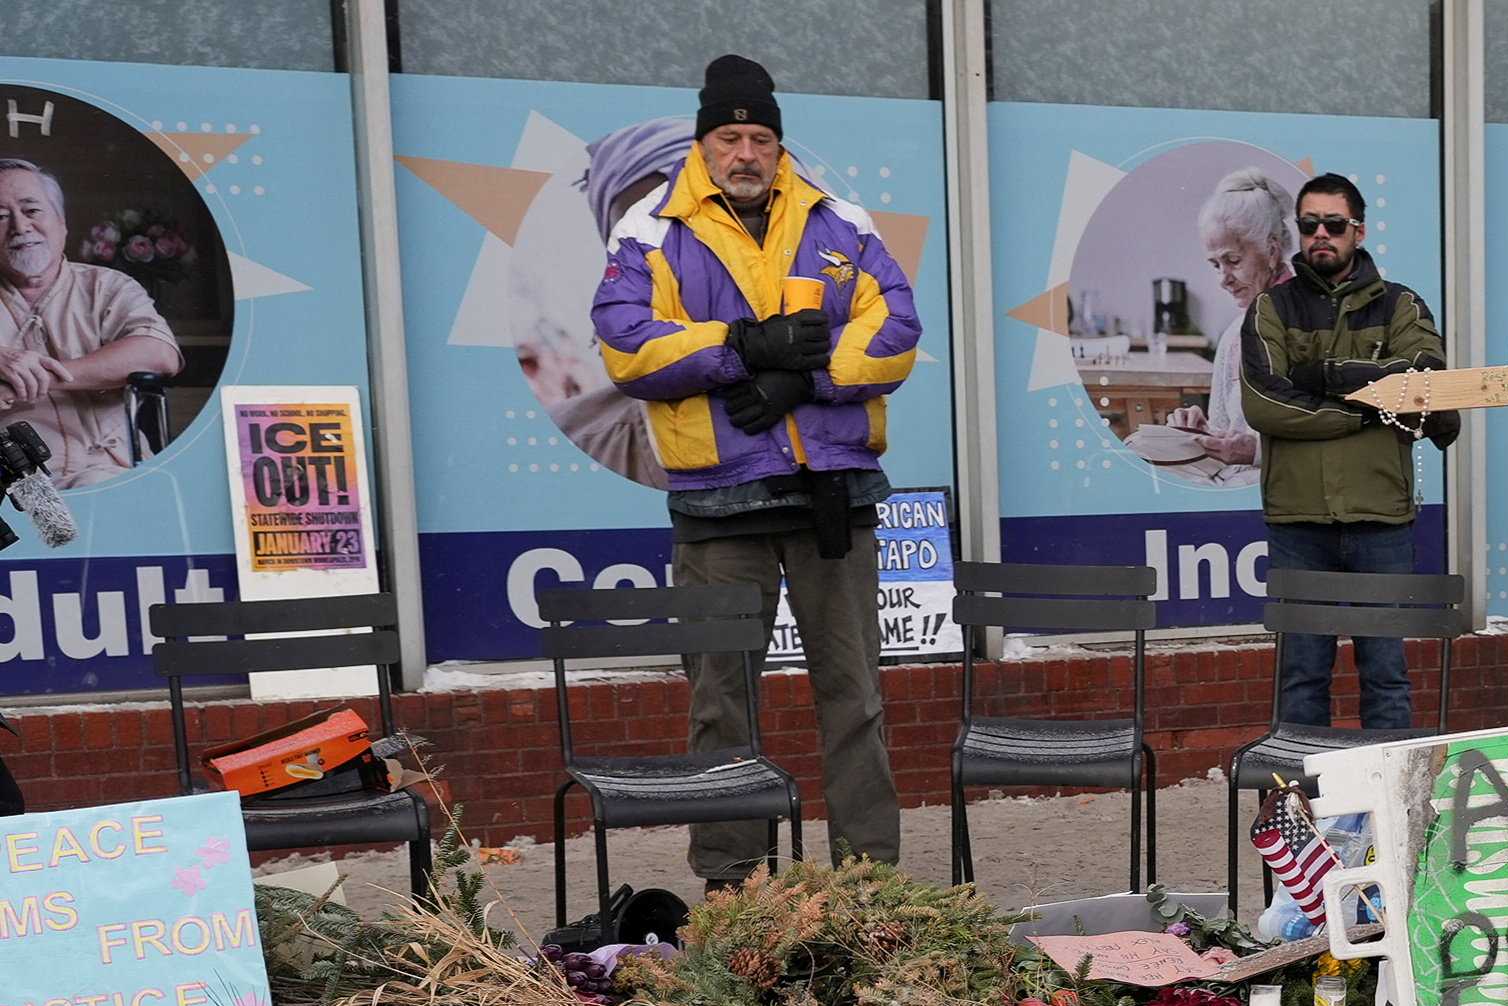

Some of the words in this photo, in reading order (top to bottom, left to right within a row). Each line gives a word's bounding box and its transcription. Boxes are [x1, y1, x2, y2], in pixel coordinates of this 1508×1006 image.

[248, 422, 345, 455] ICE
[253, 455, 350, 507] OUT!
[250, 512, 303, 527] STATEWIDE
[305, 511, 361, 526] SHUTDOWN
[875, 501, 945, 529] RICAN
[256, 531, 331, 556] JANUARY
[334, 530, 360, 555] 23
[877, 539, 938, 570] TAPO
[877, 586, 921, 610] OUR
[6, 815, 169, 873] EACE
[0, 891, 79, 940] MS
[97, 909, 256, 965] FROM
